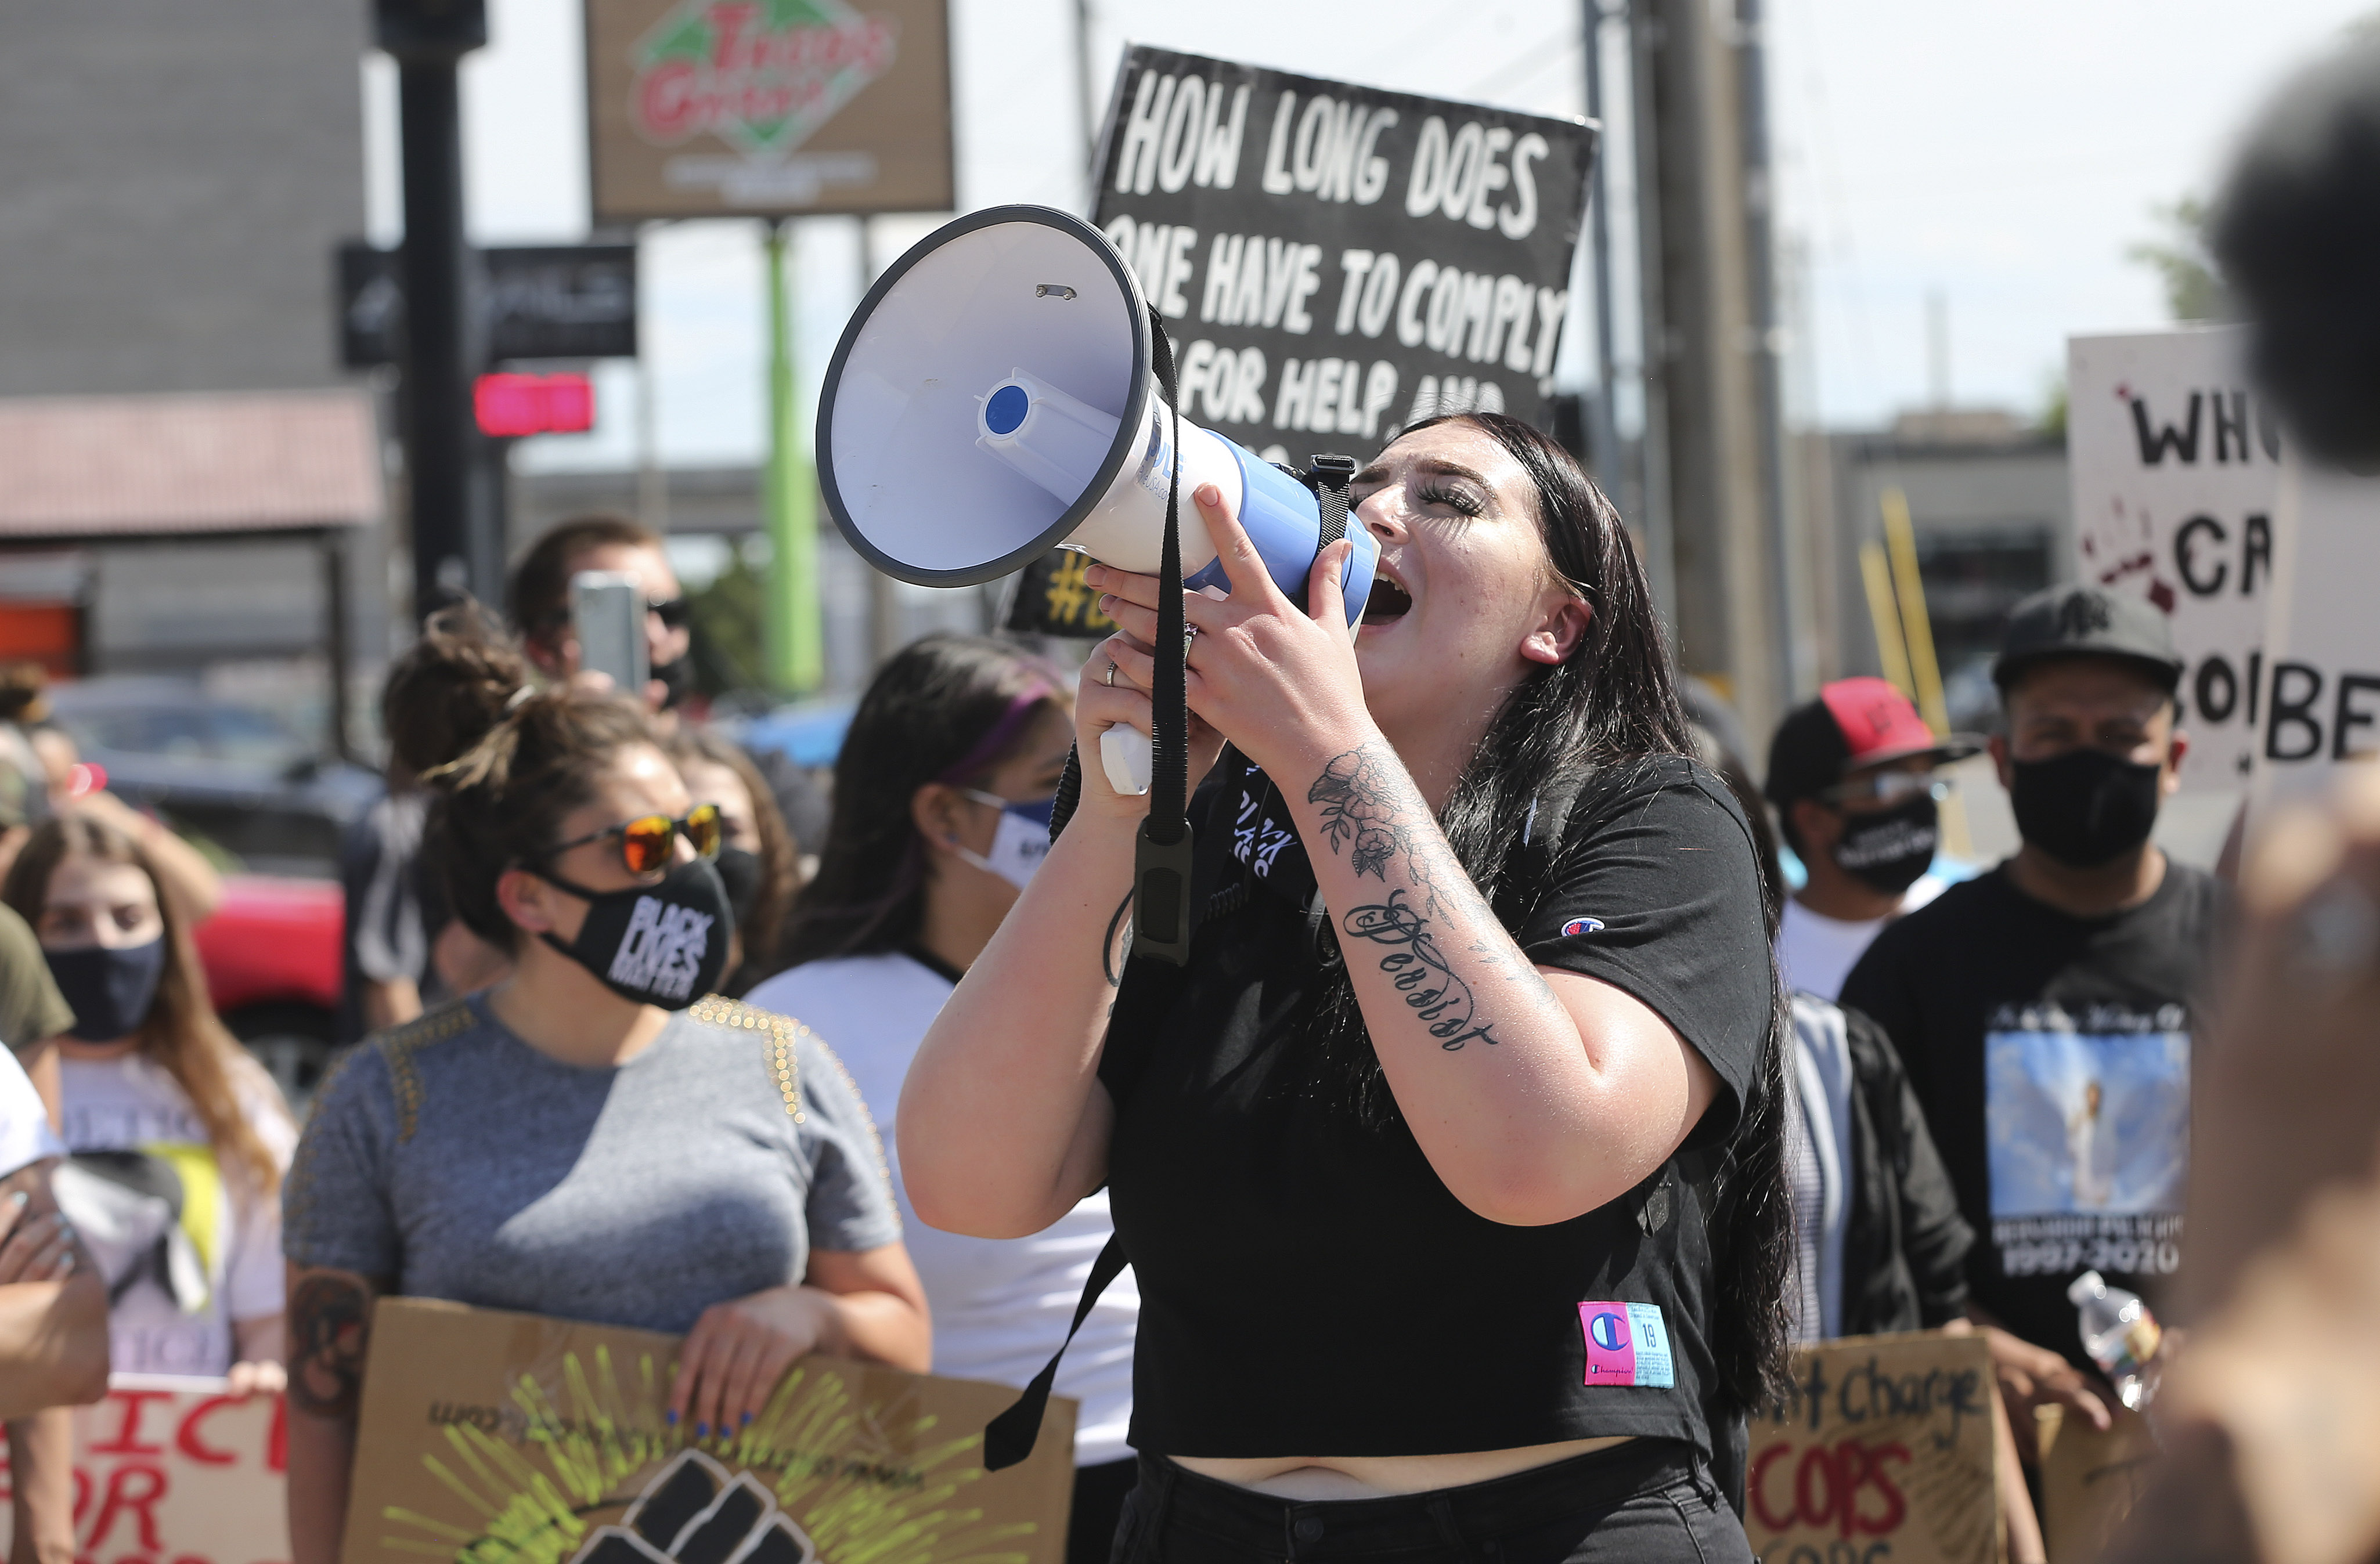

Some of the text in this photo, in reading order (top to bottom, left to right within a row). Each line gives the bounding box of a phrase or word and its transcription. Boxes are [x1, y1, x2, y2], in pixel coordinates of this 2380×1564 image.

[1116, 68, 1549, 239] HOW LONG DOES
[1200, 233, 1324, 335] HAVE
[1335, 248, 1400, 338] TO
[1396, 258, 1568, 379] COMPLY
[1178, 339, 1268, 424] FOR
[1591, 1364, 1632, 1378] Champion
[1642, 1323, 1657, 1348] 19
[1749, 1437, 1912, 1541] COPS
